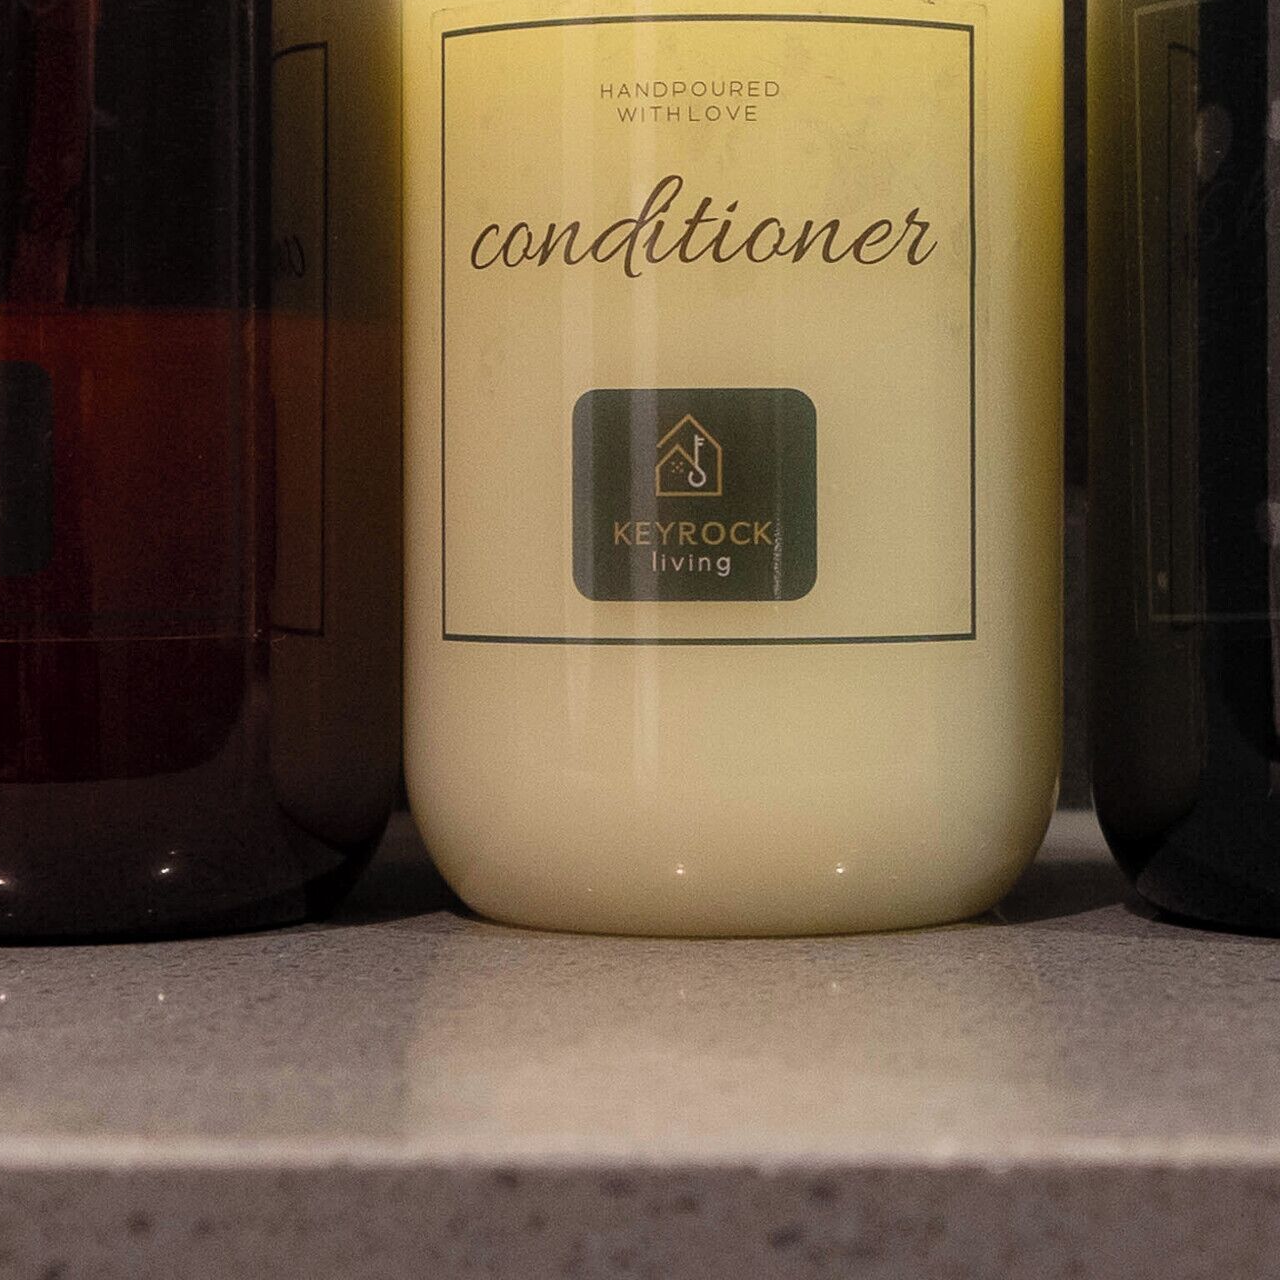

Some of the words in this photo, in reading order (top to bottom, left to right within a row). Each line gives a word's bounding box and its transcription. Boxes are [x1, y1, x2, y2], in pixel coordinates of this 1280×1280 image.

[599, 81, 781, 98] HANDPOURED
[470, 175, 937, 278] conditioner
[613, 521, 773, 546] KEYROCK
[651, 551, 732, 577] living
